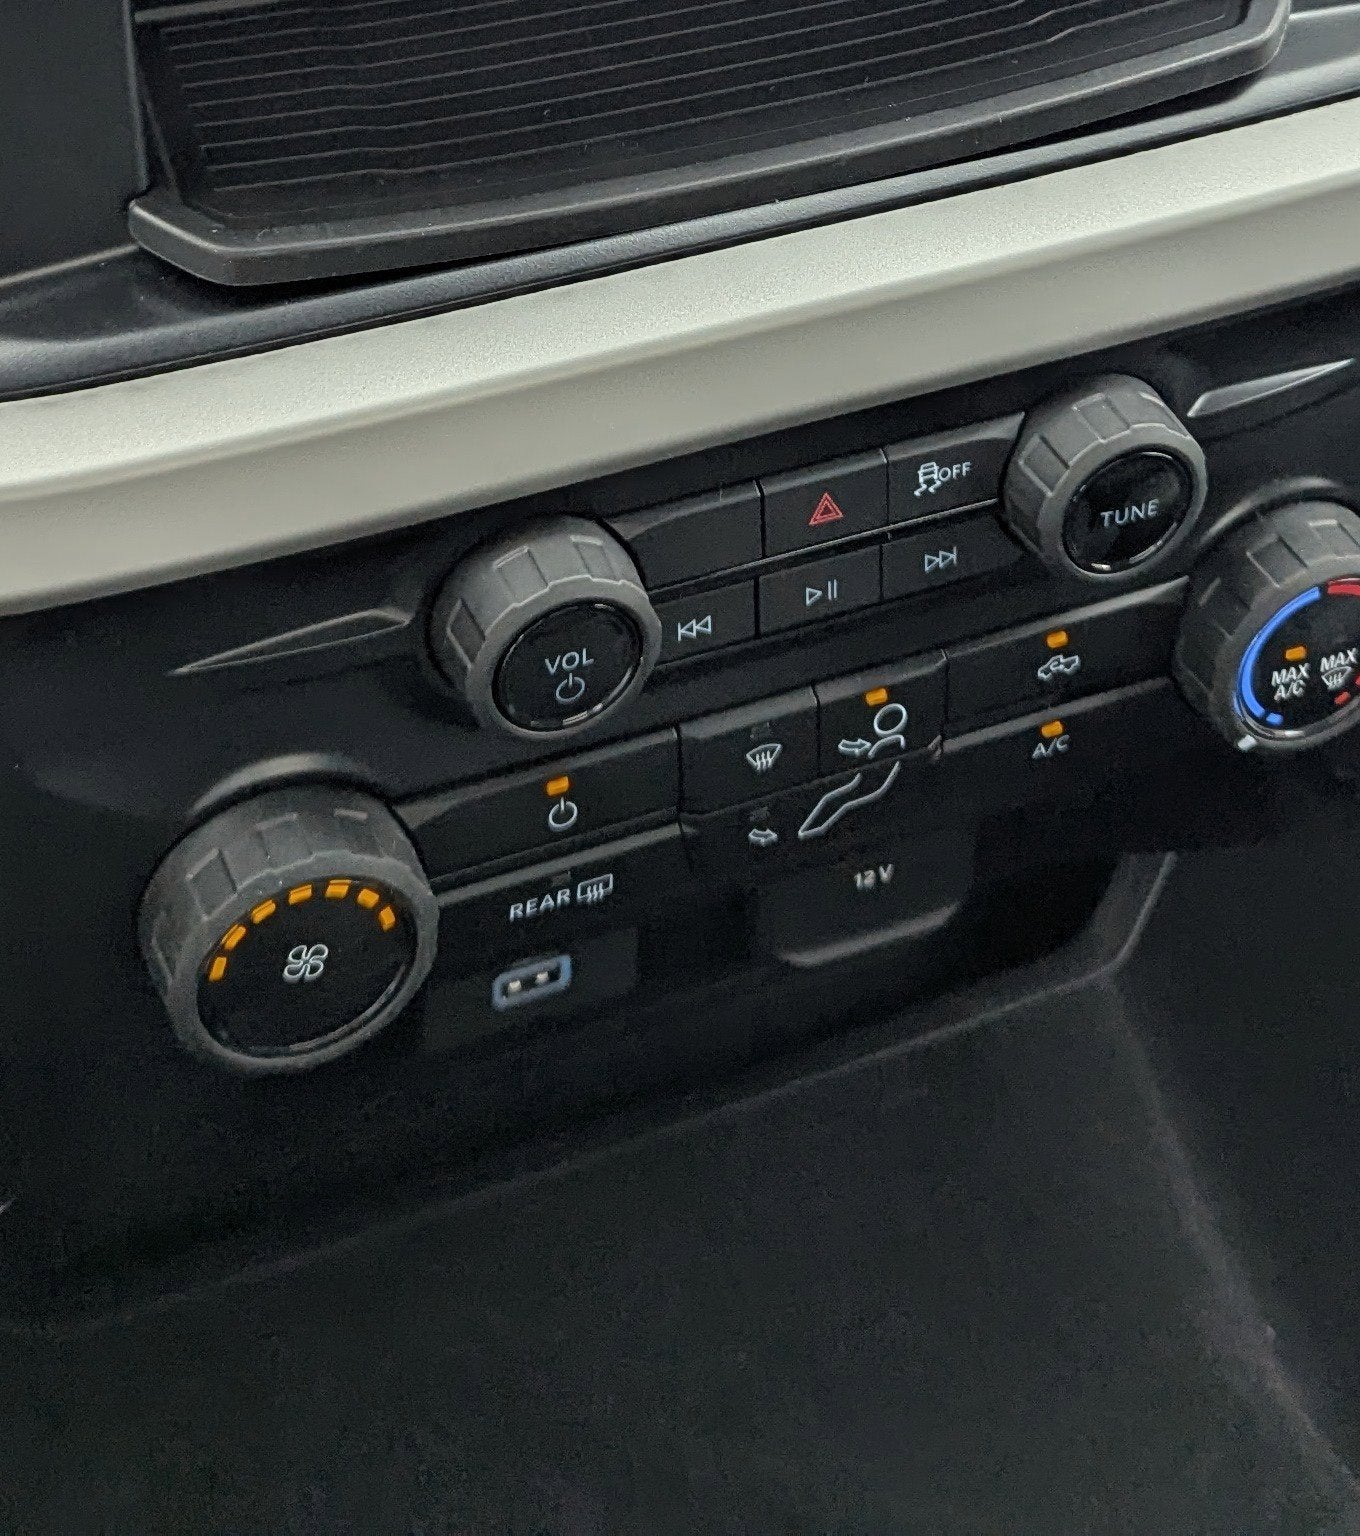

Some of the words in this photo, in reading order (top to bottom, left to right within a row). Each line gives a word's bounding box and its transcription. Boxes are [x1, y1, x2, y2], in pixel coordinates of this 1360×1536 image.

[939, 459, 973, 482] OFF
[1099, 498, 1161, 529] TUNE
[543, 646, 596, 677] VOL
[1319, 645, 1359, 673] MAX
[1271, 663, 1311, 688] MAX
[1273, 680, 1307, 702] A/C
[1031, 735, 1071, 760] A/C
[508, 886, 572, 923] REAR
